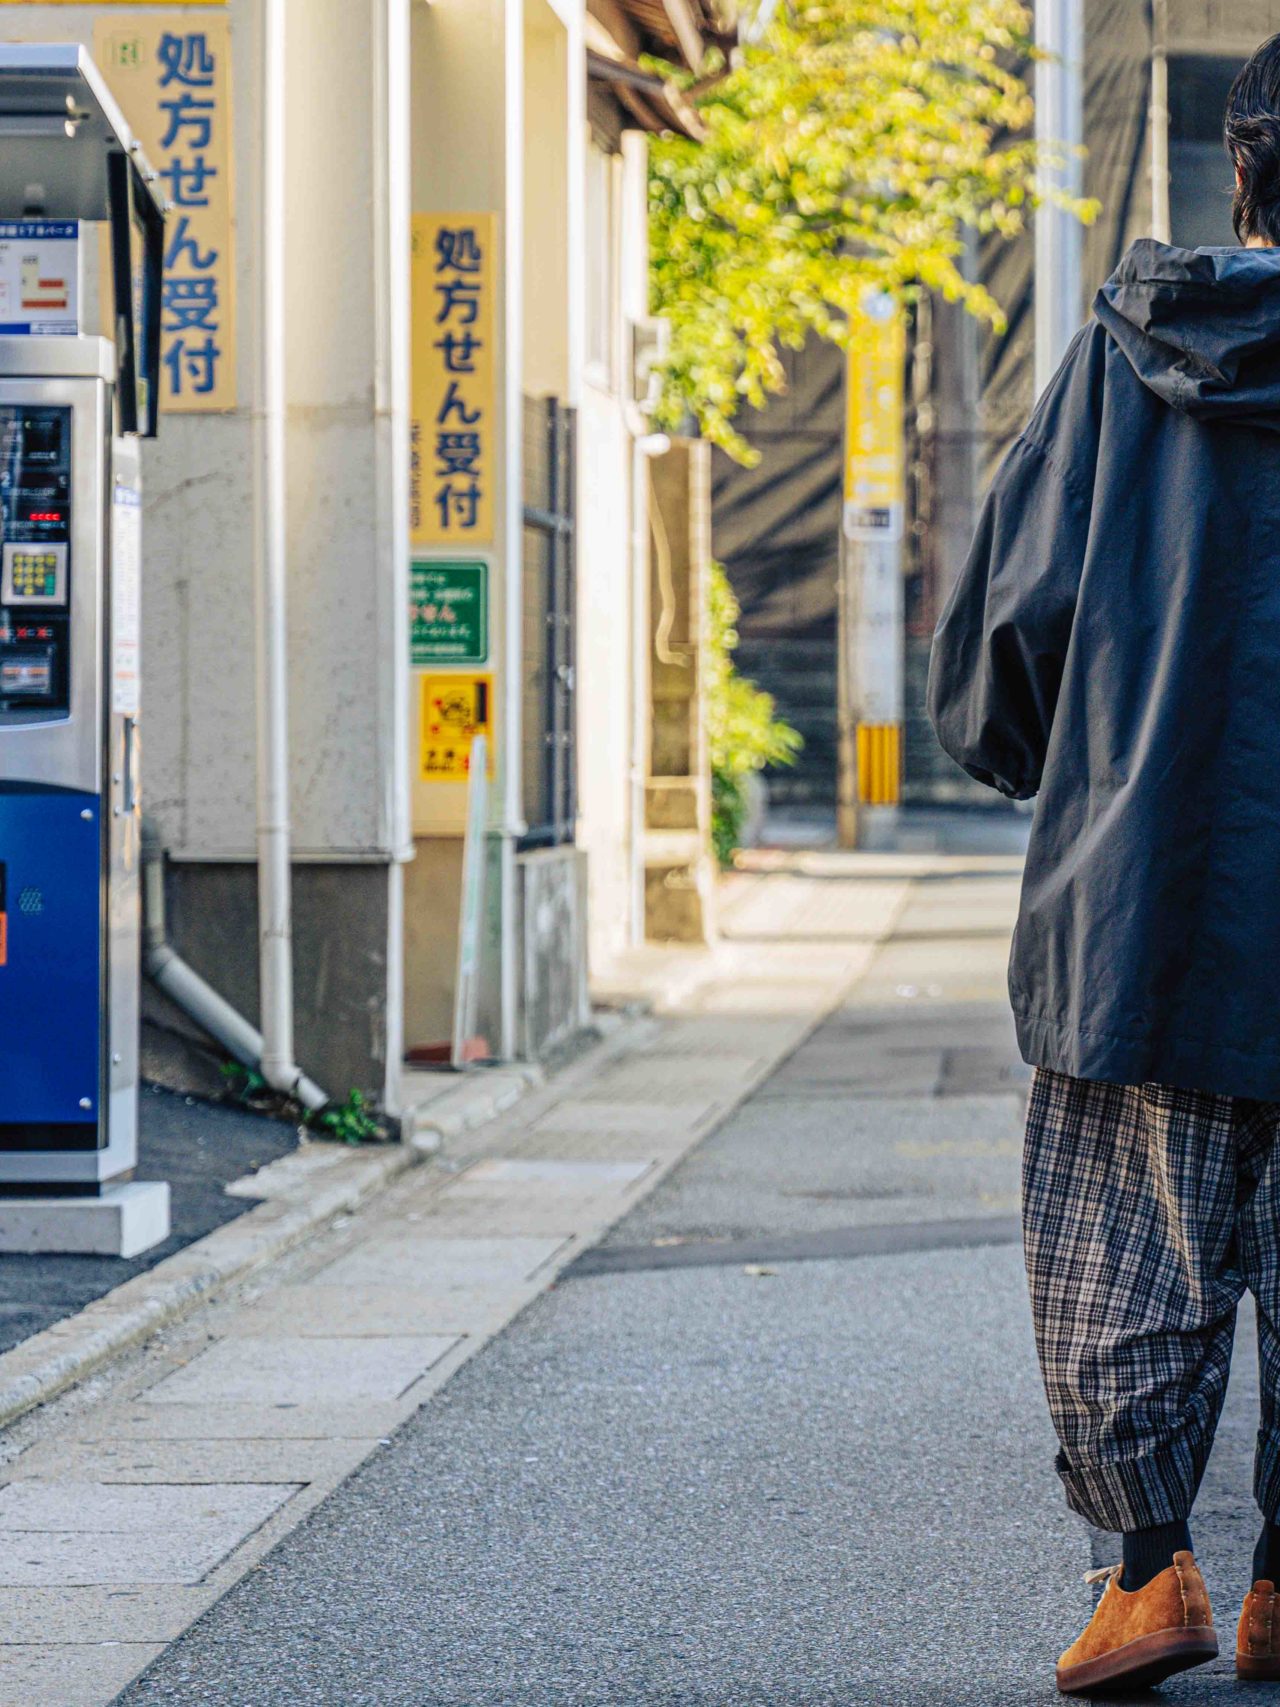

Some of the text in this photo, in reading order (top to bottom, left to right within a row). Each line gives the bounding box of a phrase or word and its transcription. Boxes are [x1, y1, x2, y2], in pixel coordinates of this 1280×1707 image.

[156, 31, 221, 396] 処方せん受付
[433, 227, 483, 530] 処方せん受付
